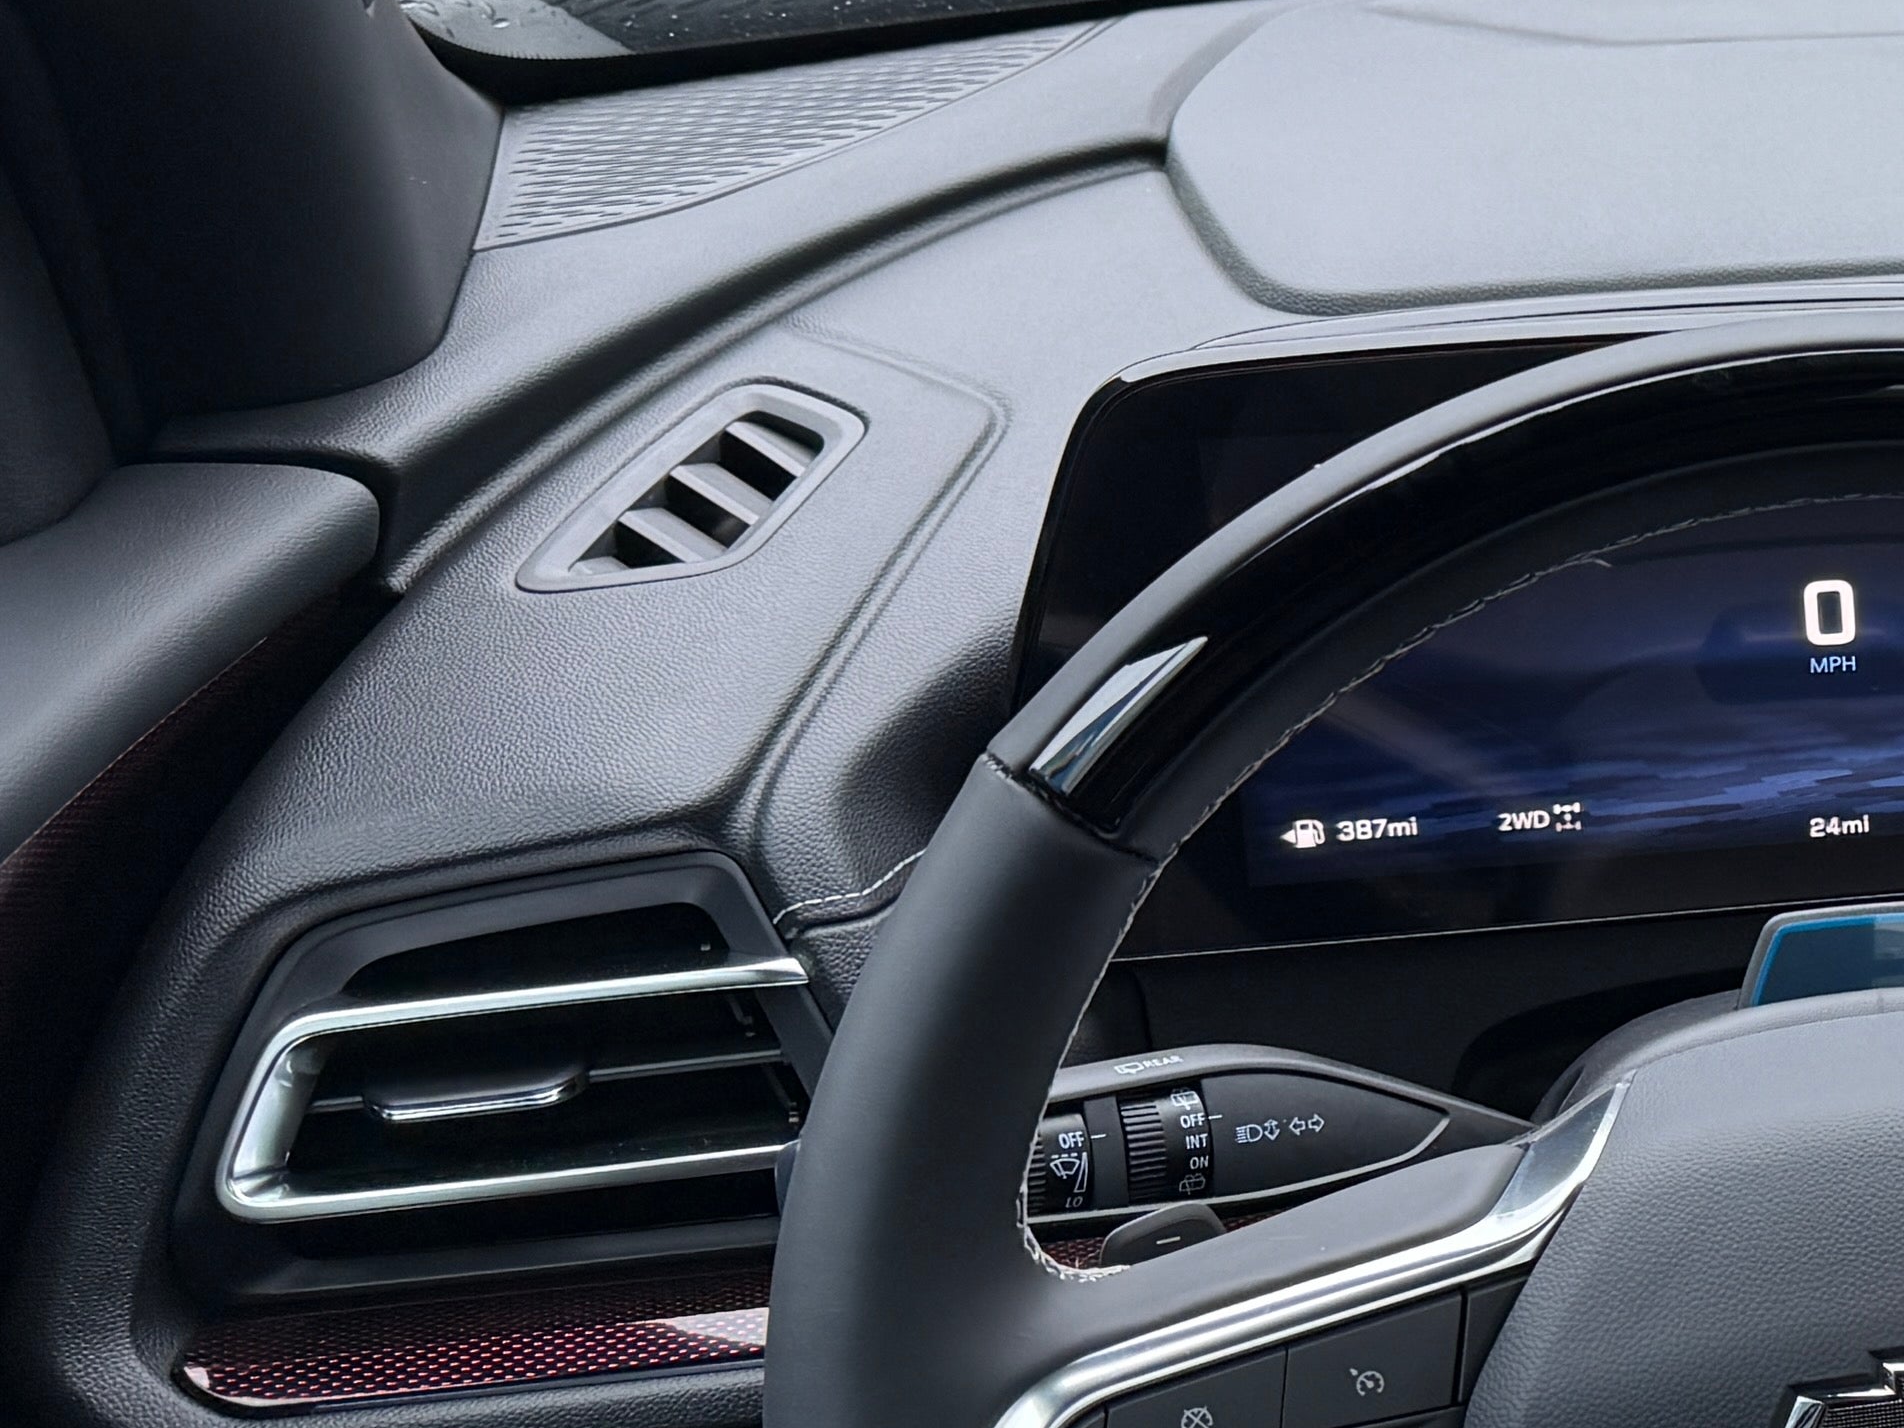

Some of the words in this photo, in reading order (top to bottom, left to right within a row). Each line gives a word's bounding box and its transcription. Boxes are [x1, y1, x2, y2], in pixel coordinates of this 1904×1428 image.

[1803, 579, 1856, 647] 0
[1809, 655, 1856, 674] MPH
[1336, 815, 1418, 842] 387mi
[1498, 810, 1550, 832] 2WD
[1809, 814, 1869, 838] 24mi
[1143, 1055, 1184, 1069] REAR
[1180, 1113, 1206, 1129] OFF
[1059, 1132, 1085, 1149] OFF
[1185, 1134, 1208, 1150] INT
[1189, 1156, 1210, 1170] ON
[1065, 1196, 1084, 1208] LO
